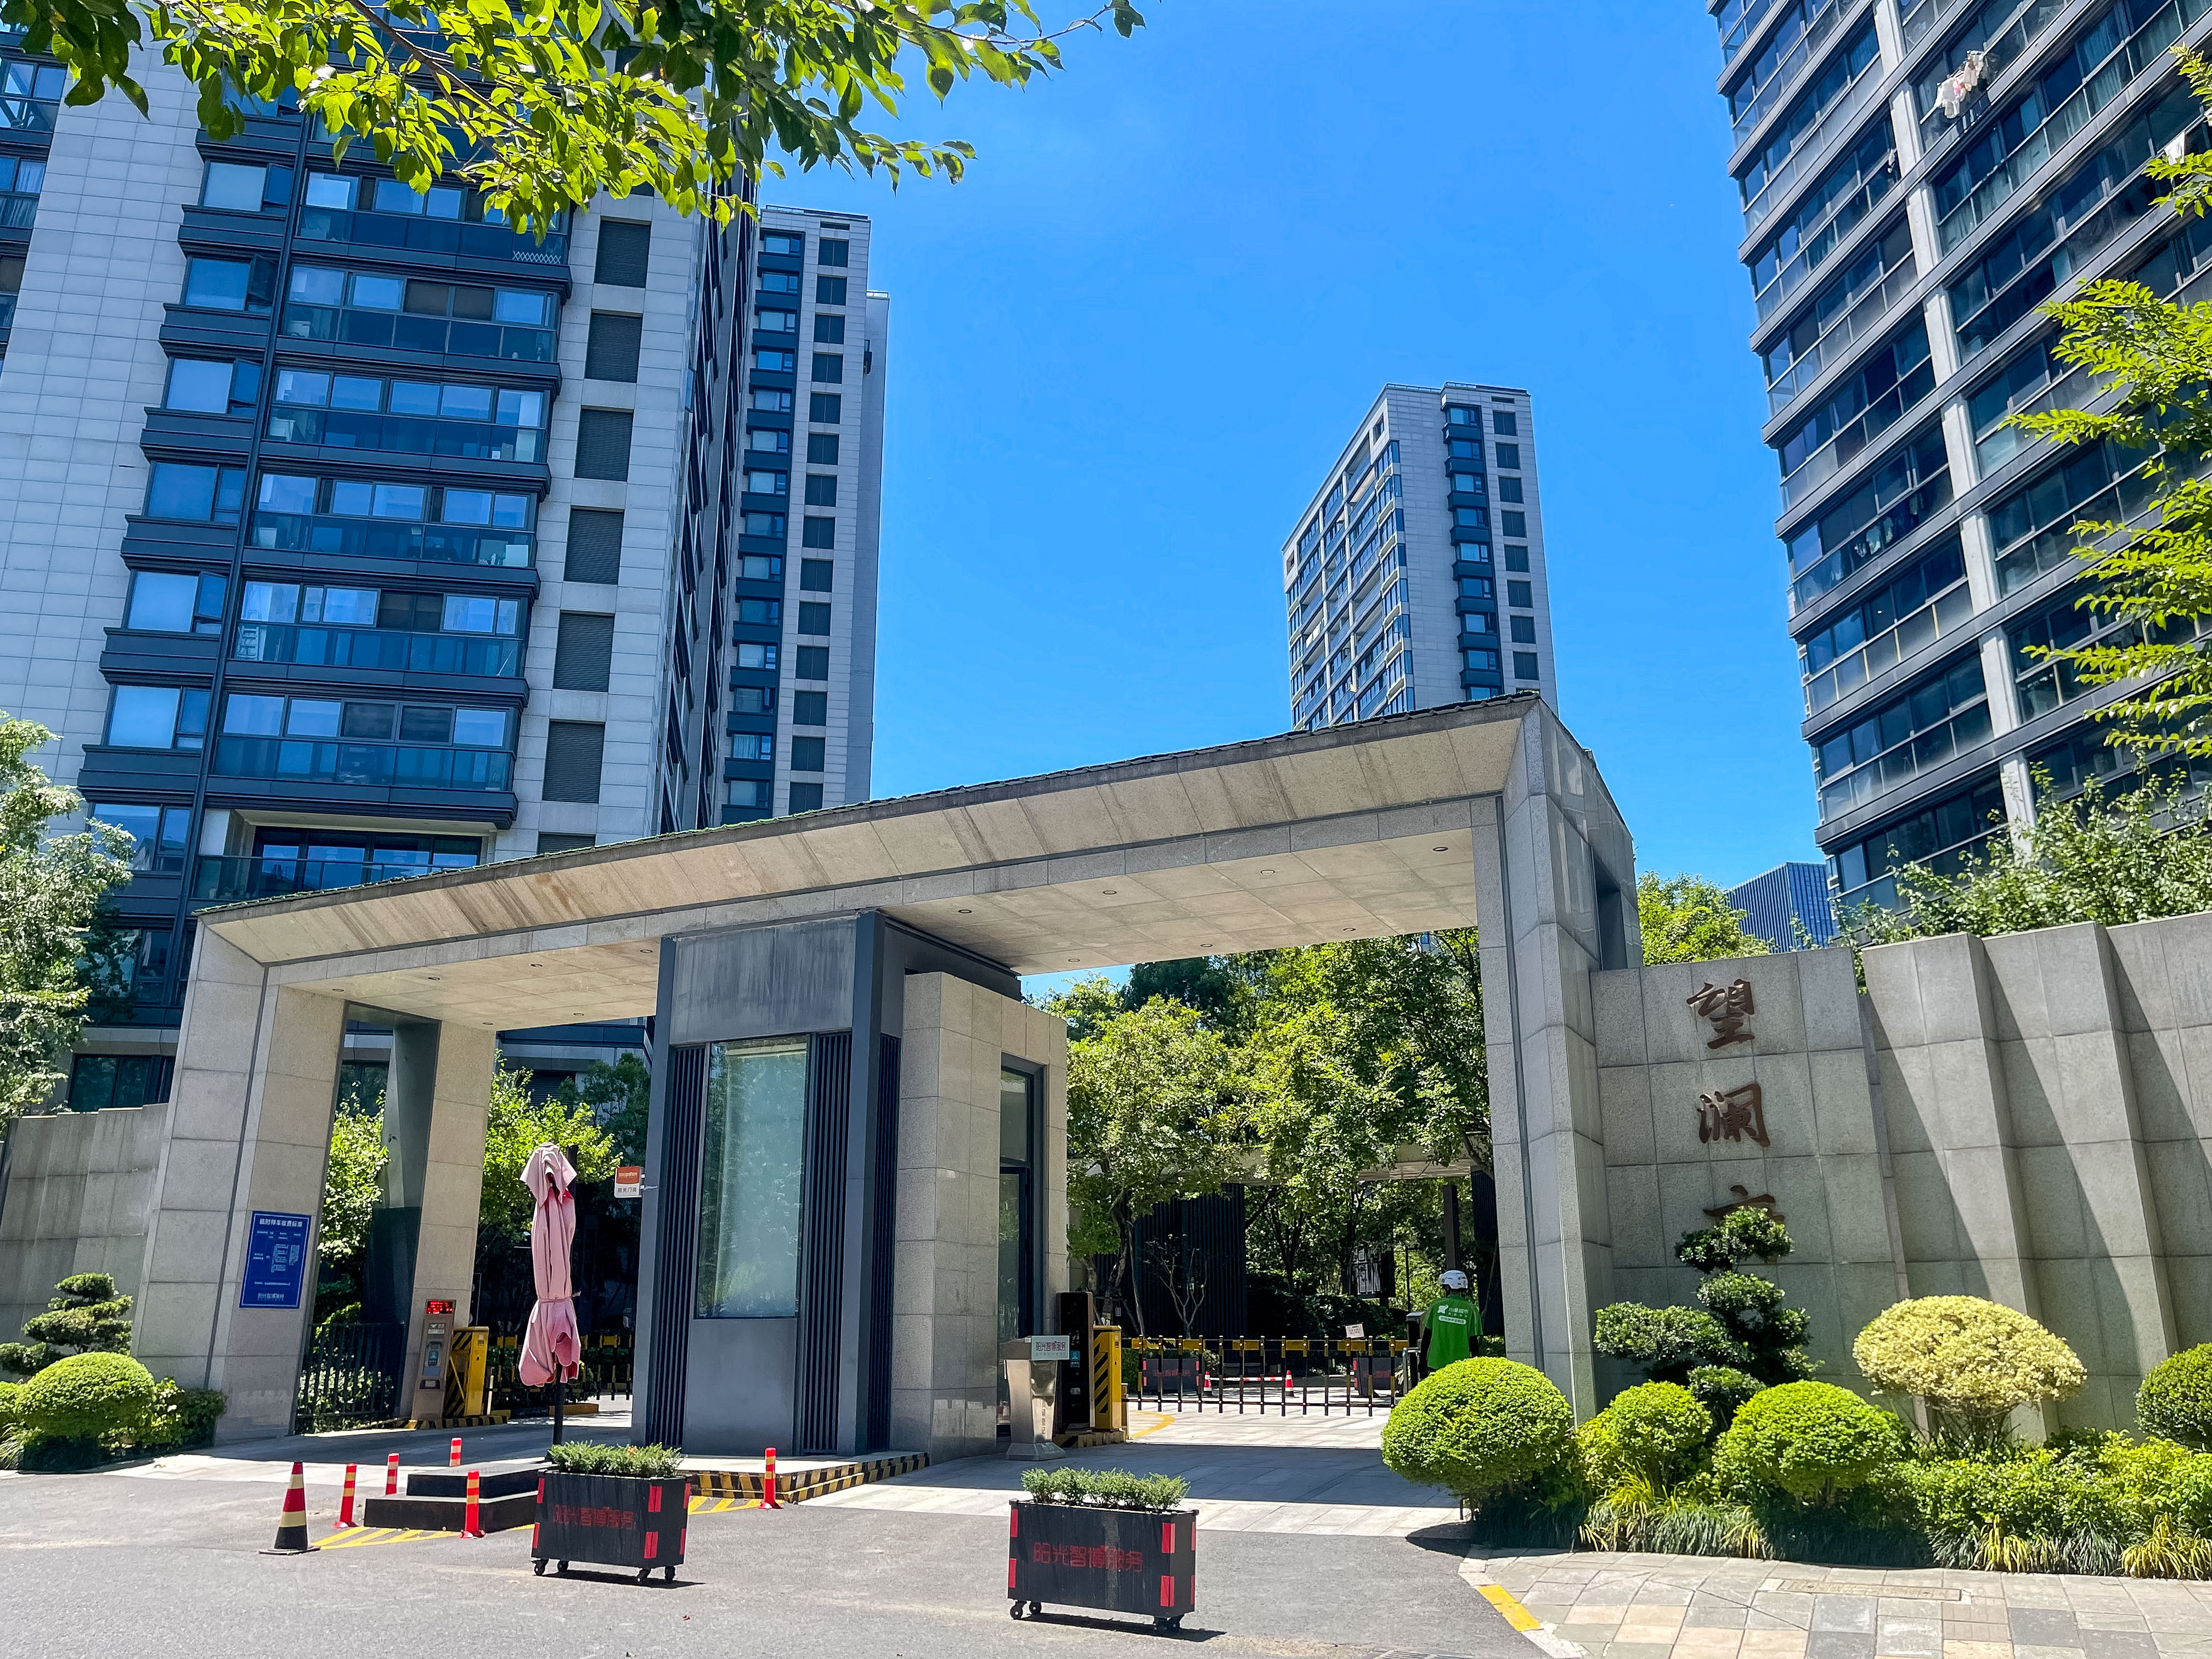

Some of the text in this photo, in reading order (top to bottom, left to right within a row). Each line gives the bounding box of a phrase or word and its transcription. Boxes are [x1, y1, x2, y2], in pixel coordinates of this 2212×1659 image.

[1686, 979, 1785, 1265] 望澜
[259, 1218, 302, 1227] 临时停车收费标准
